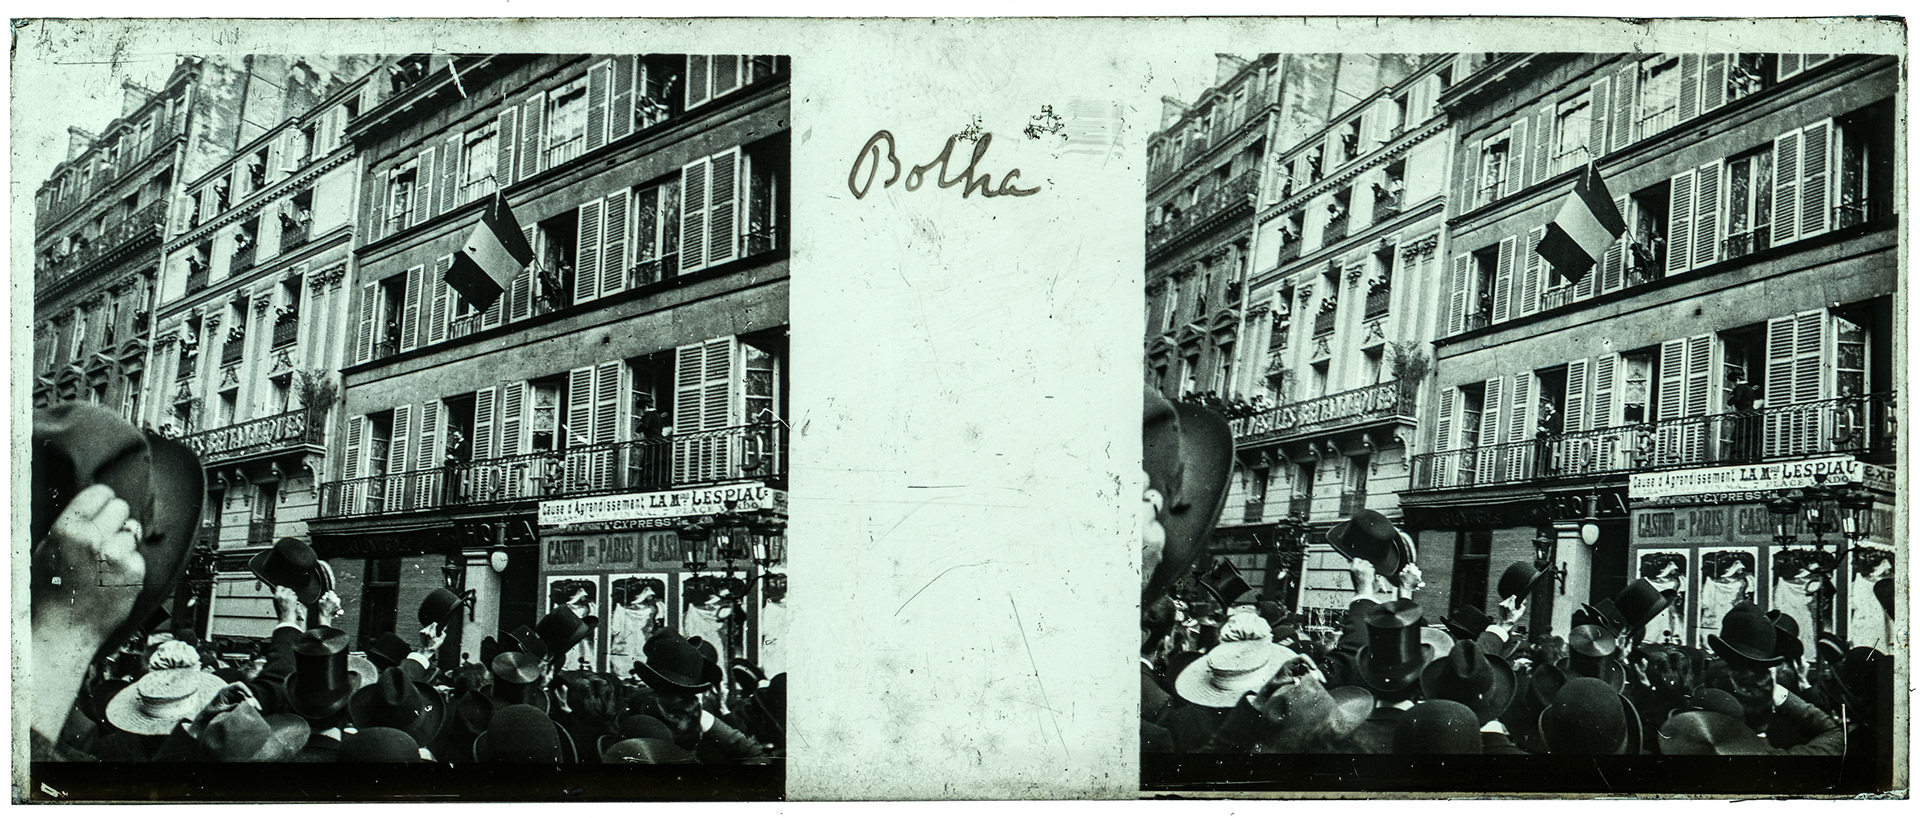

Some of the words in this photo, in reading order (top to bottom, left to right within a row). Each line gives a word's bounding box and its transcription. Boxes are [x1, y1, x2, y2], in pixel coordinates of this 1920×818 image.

[1740, 468, 1758, 481] LA
[1782, 460, 1859, 479] LESPIAU
[650, 494, 667, 508] LA
